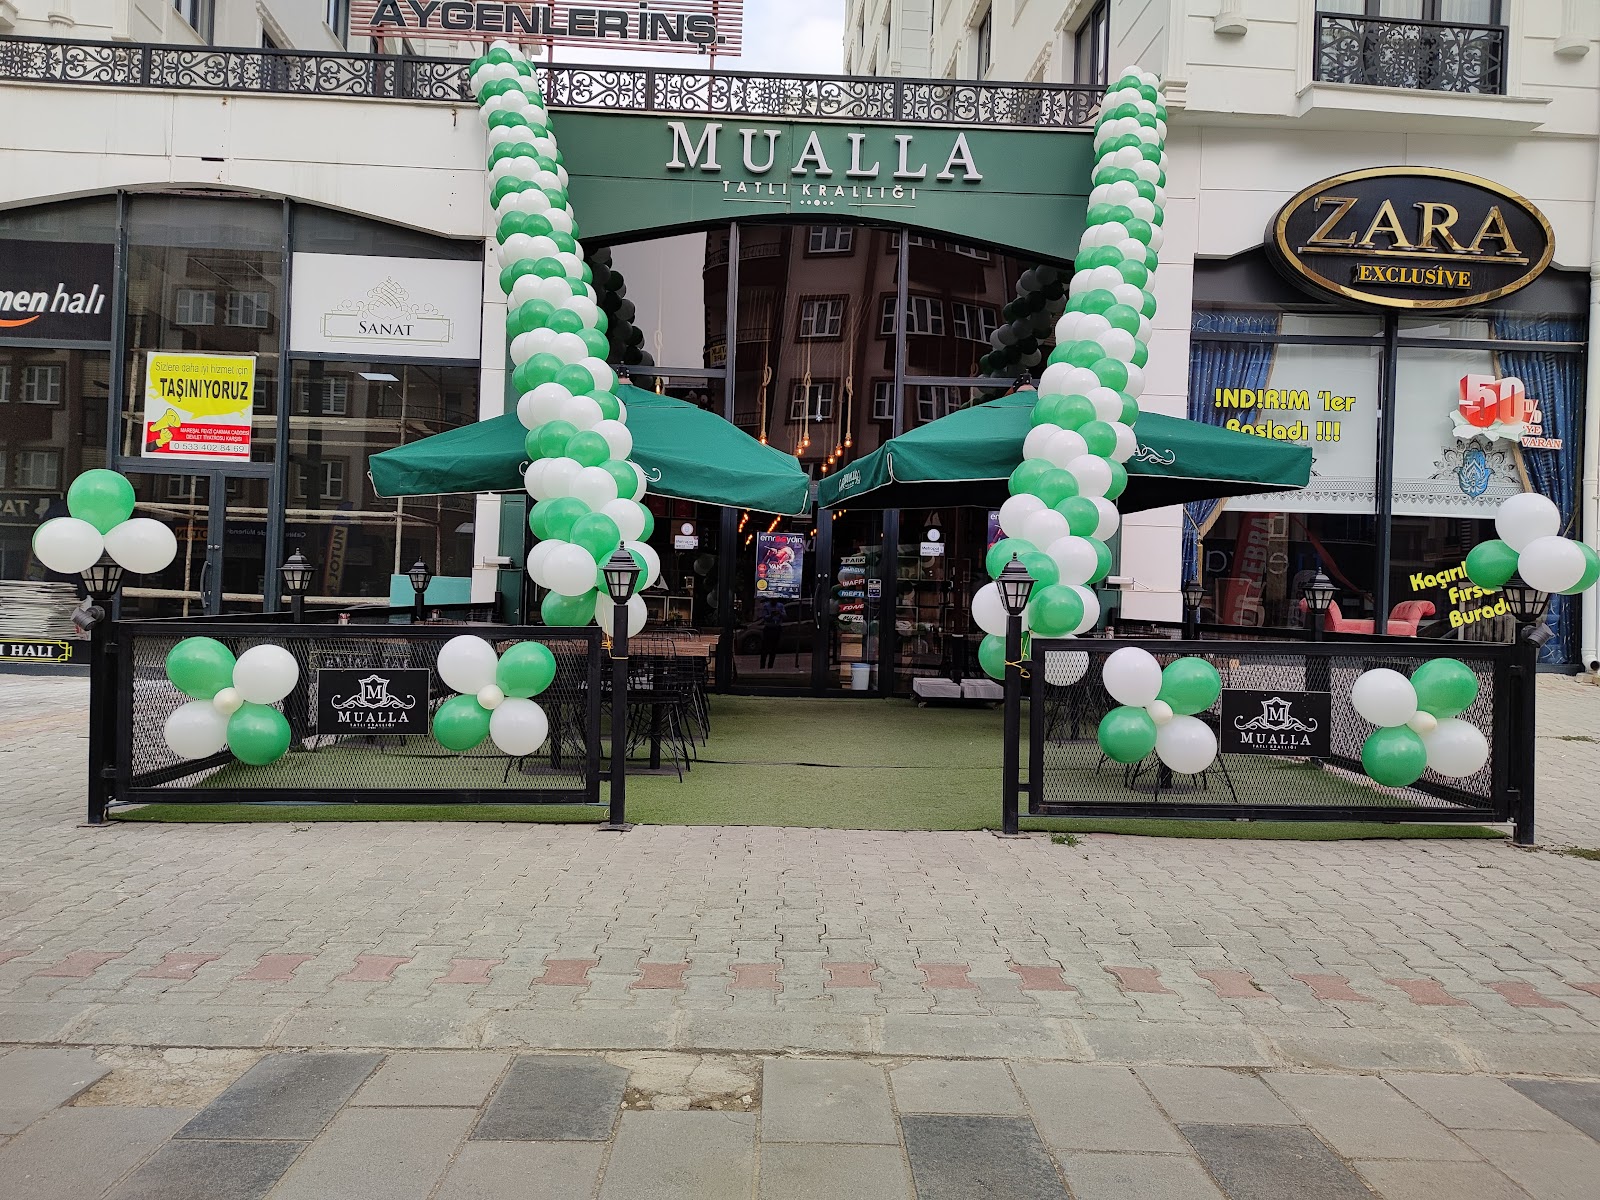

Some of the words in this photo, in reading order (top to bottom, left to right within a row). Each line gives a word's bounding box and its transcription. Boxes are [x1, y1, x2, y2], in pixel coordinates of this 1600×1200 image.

[370, 0, 630, 39] AYGENLER
[665, 121, 984, 182] MUALLA
[722, 180, 787, 195] TATLI
[802, 183, 917, 200] KRALLIĞI
[1306, 196, 1523, 257] ZARA
[358, 320, 415, 336] SANAT
[155, 361, 180, 372] Sizlere
[181, 363, 200, 373] daha
[200, 364, 209, 375] iyi
[210, 364, 235, 374] hizmet
[236, 366, 249, 377] için
[159, 377, 249, 402] TAŞINIYORUZ
[173, 442, 180, 450] 0
[201, 444, 218, 452] 402
[219, 444, 231, 452] 84
[1521, 437, 1562, 449] VARAN
[10, 644, 54, 658] HALI
[366, 685, 383, 700] M
[337, 711, 410, 723] MUALLA
[1268, 707, 1285, 721] M
[1240, 731, 1312, 746] MUALLA
